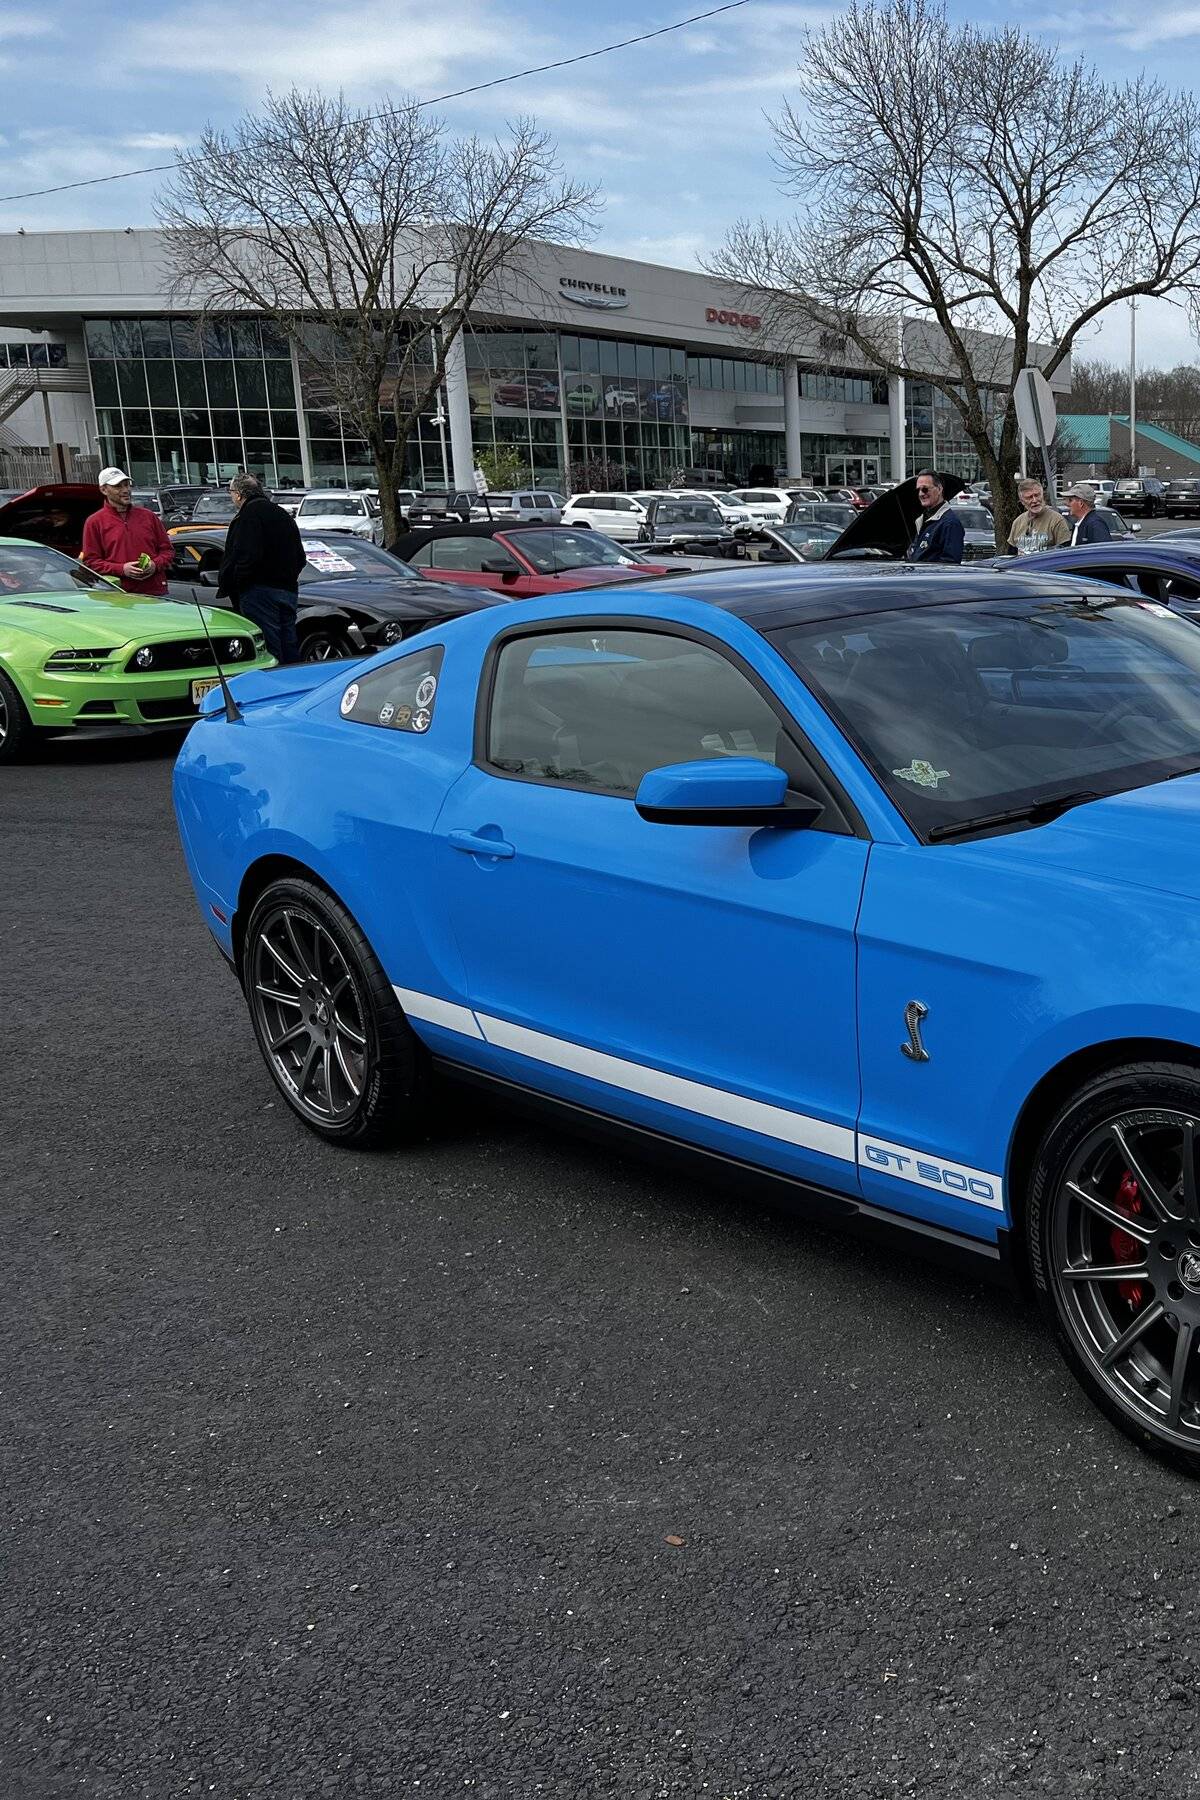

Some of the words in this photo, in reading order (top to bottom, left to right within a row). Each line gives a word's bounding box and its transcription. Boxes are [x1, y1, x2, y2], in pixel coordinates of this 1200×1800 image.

[558, 277, 627, 297] CHRYSLER
[864, 1144, 911, 1171] GT
[916, 1160, 995, 1200] 500
[1030, 1160, 1049, 1292] BRIDGESTONE
